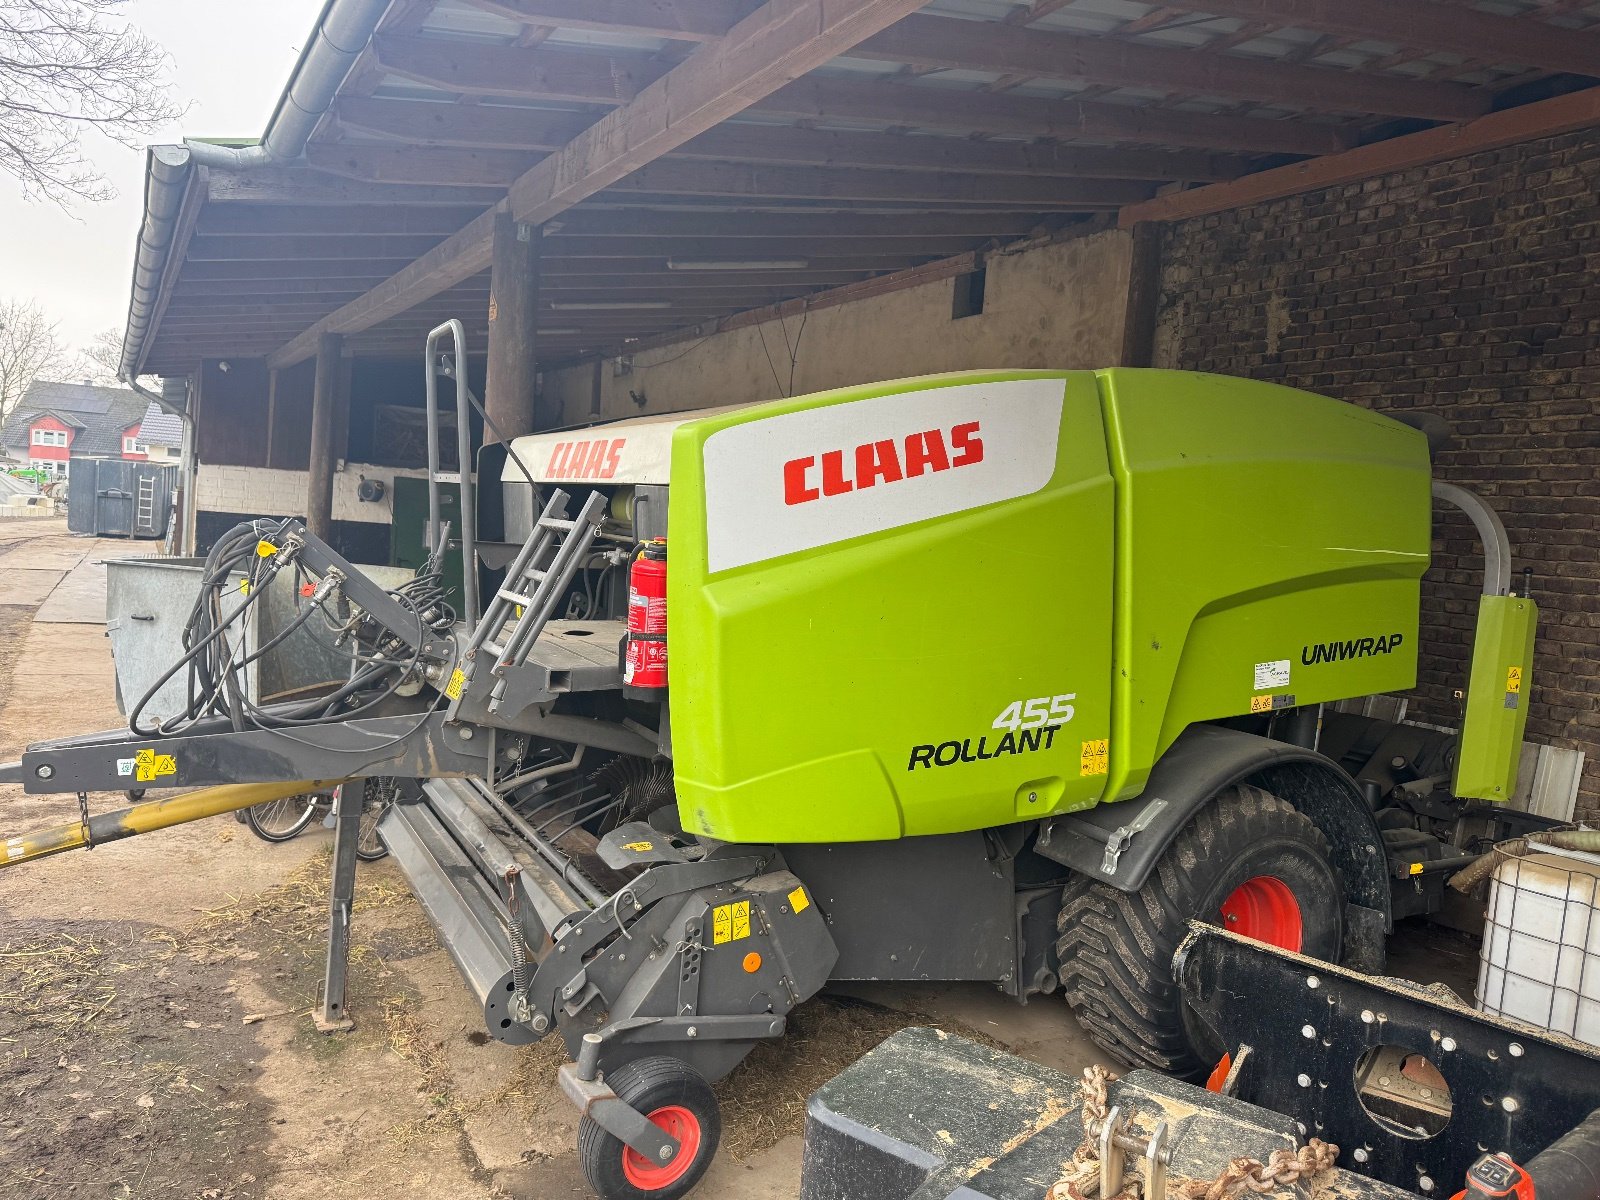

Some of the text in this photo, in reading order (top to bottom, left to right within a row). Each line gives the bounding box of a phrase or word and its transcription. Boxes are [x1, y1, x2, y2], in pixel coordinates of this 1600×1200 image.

[545, 438, 626, 478] CLAAS
[784, 421, 984, 505] CLAAS
[1301, 633, 1403, 666] UNIWRAP
[992, 693, 1077, 731] 455
[907, 724, 1061, 771] ROLLANT
